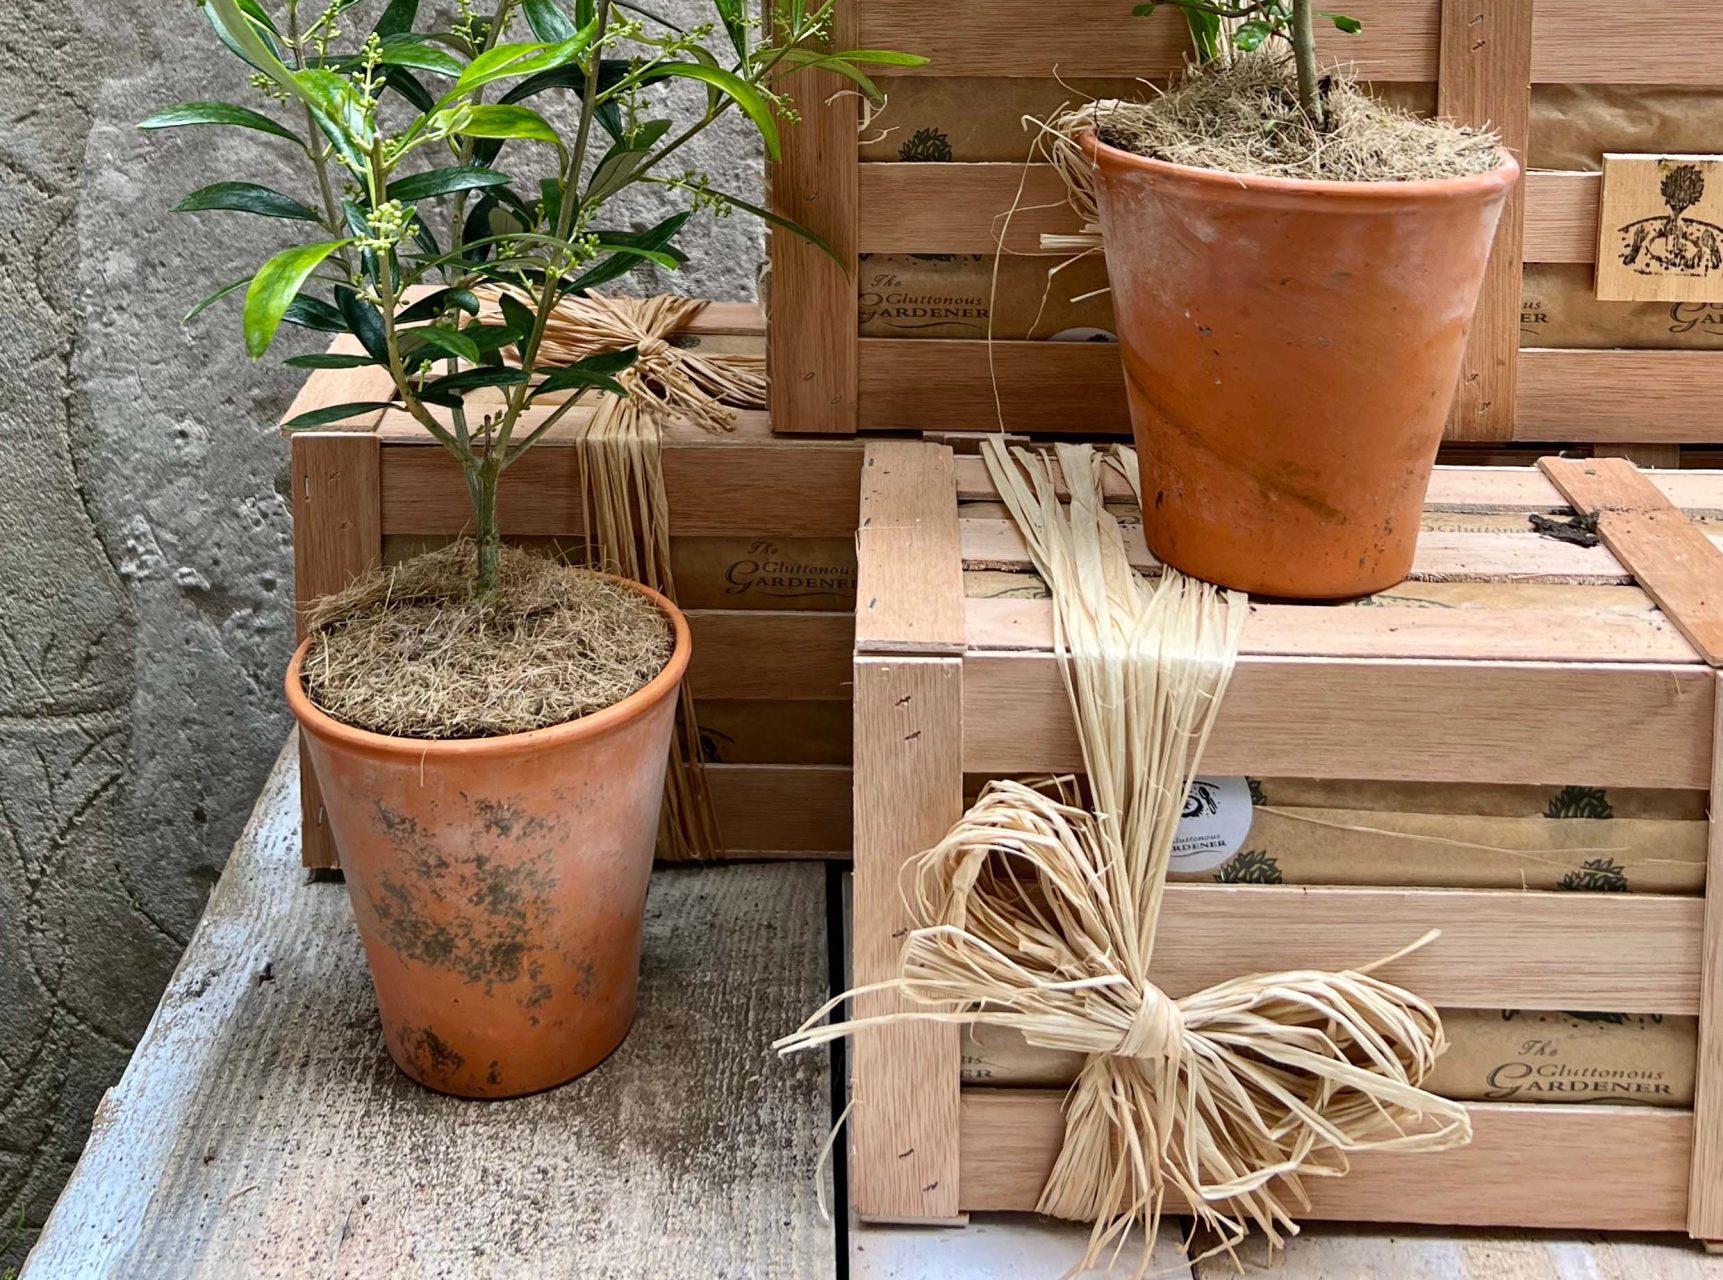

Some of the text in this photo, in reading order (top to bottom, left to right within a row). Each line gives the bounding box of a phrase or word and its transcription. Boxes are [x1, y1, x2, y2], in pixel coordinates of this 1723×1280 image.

[871, 273, 902, 288] The
[886, 293, 983, 306] Gluttonous
[747, 541, 778, 555] The
[1171, 840, 1227, 852] RDENER
[1518, 1040, 1558, 1057] The
[1485, 1063, 1671, 1097] GARDENER
[1536, 1064, 1664, 1081] Gluttonous
